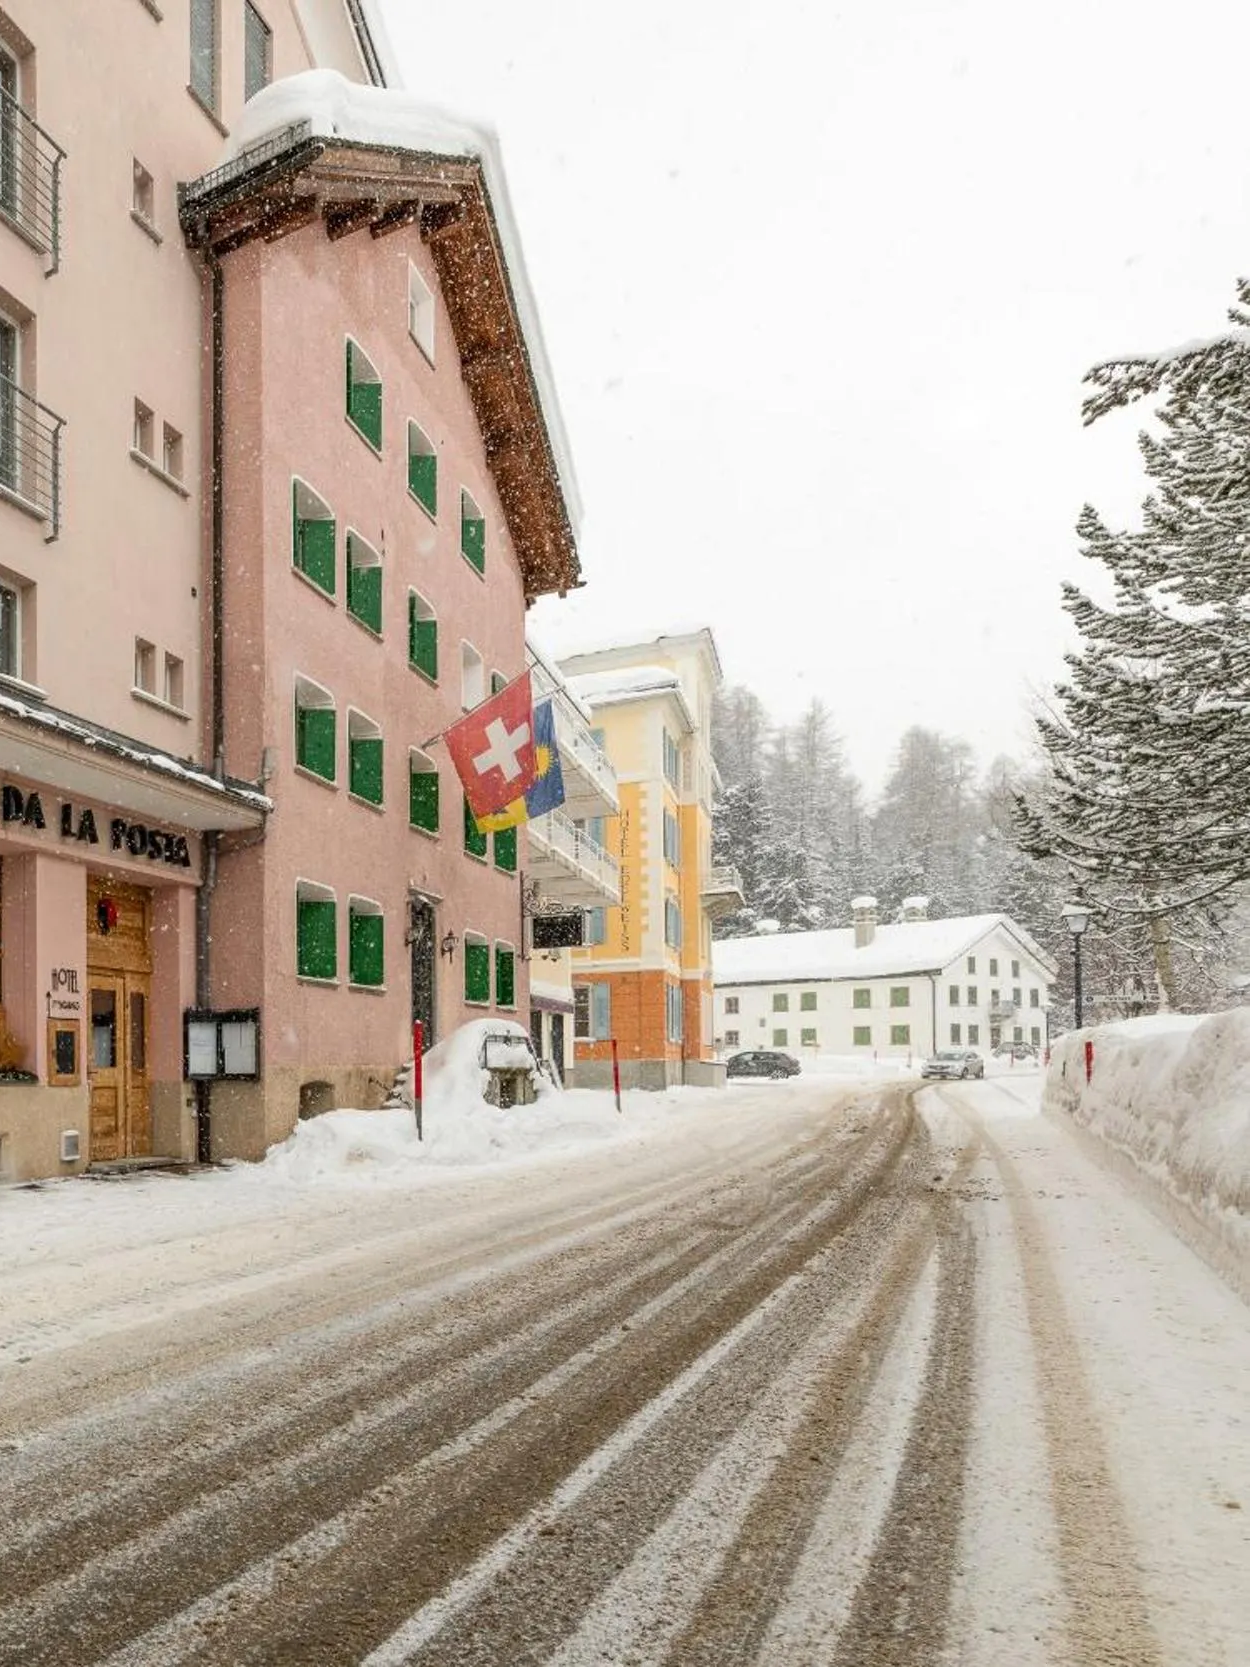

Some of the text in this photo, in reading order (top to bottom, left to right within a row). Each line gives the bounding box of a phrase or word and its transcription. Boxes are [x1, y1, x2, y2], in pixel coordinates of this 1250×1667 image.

[2, 785, 46, 829] DA
[60, 803, 99, 844] LA
[110, 818, 191, 868] POSTA
[52, 968, 80, 993] HOTEL
